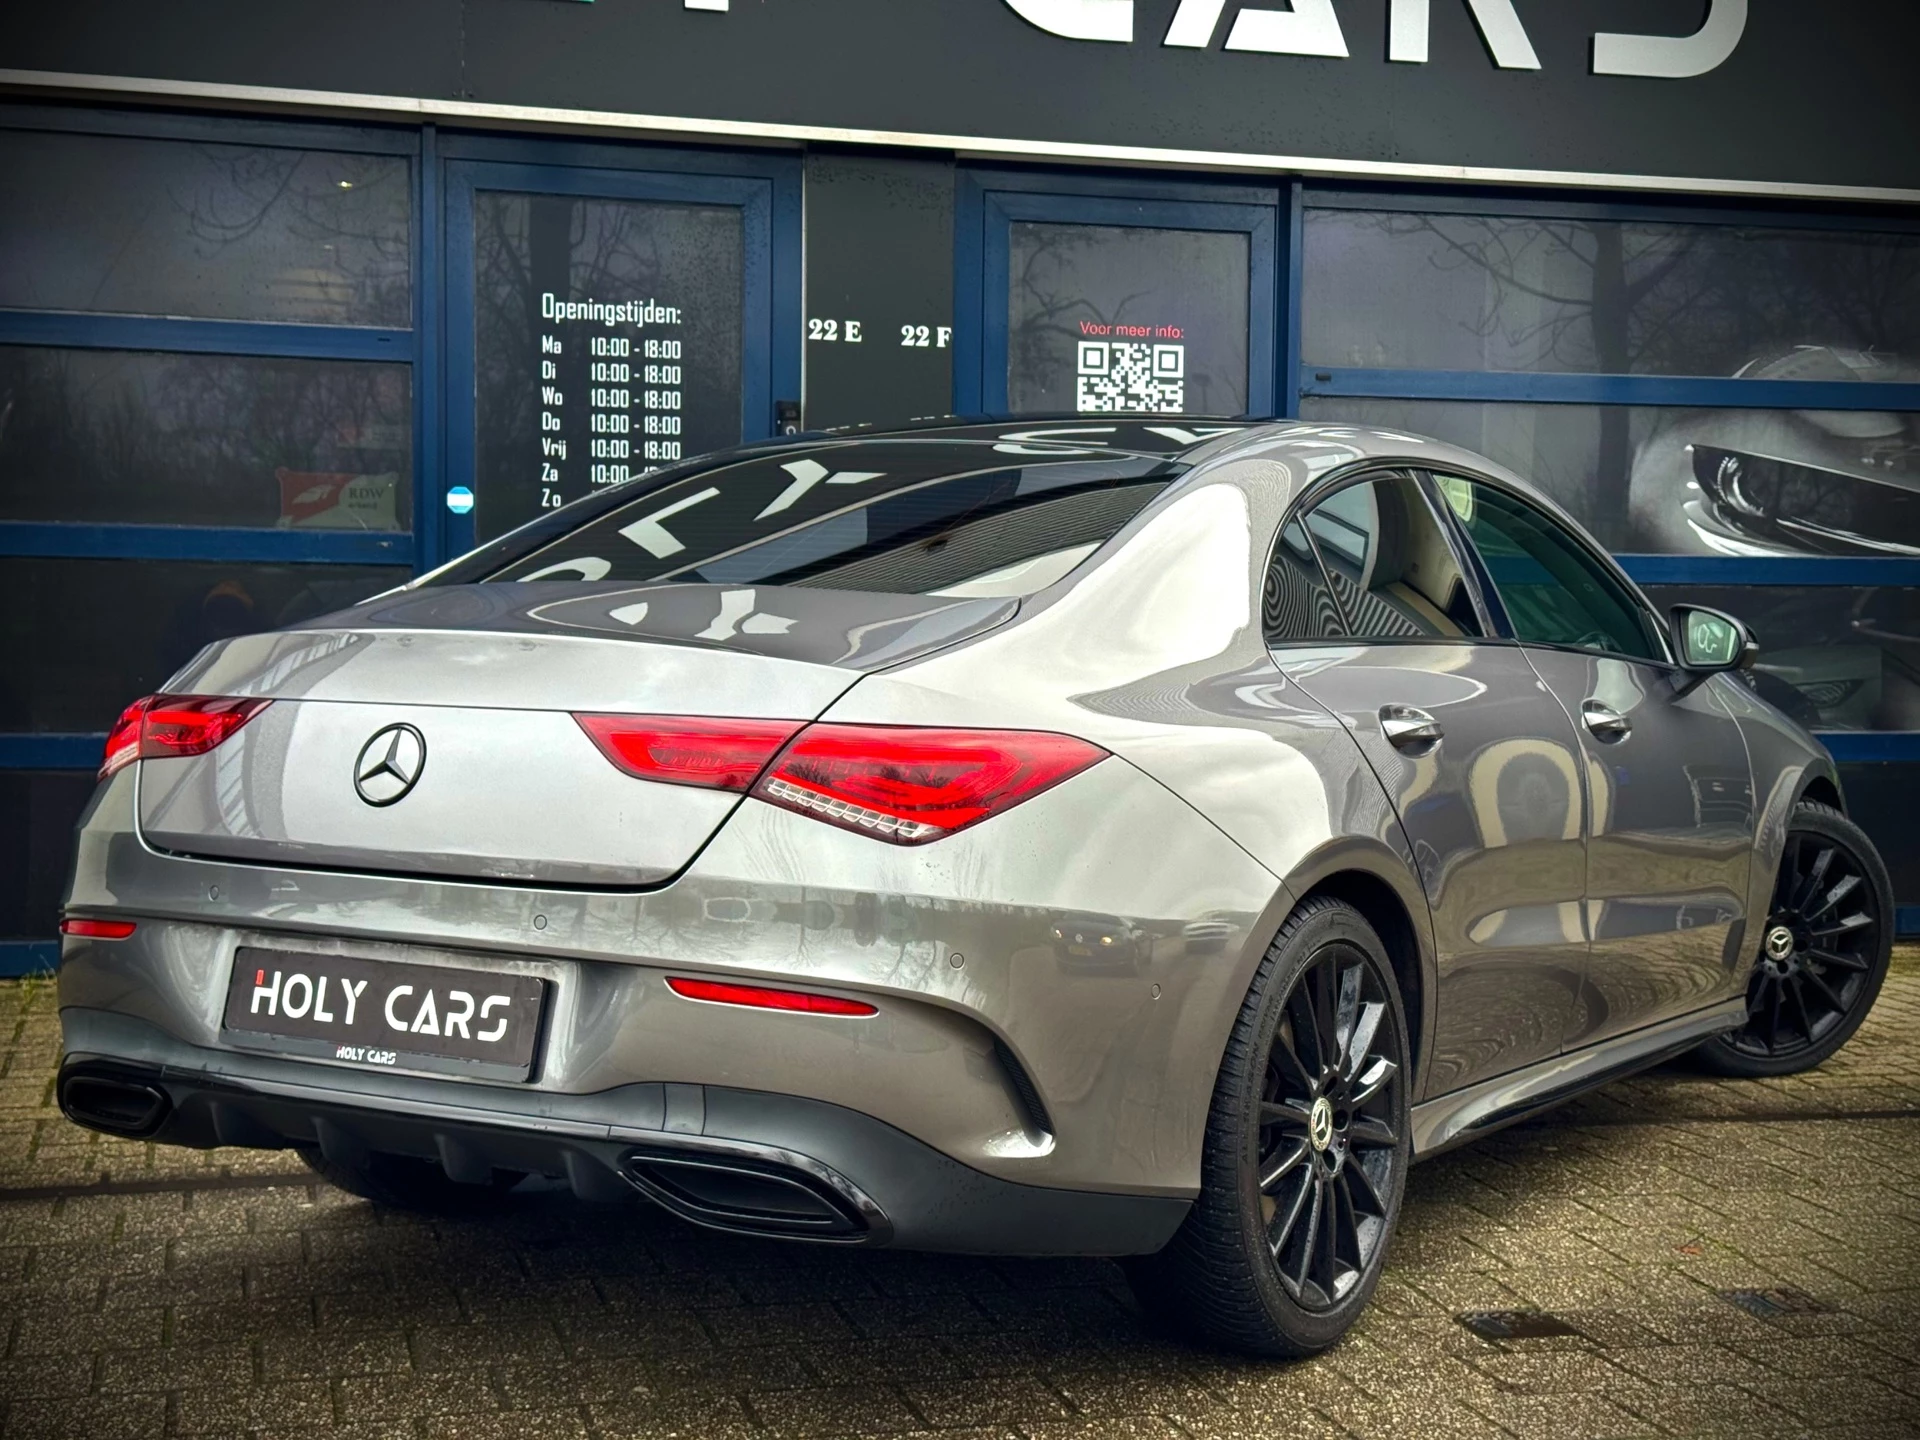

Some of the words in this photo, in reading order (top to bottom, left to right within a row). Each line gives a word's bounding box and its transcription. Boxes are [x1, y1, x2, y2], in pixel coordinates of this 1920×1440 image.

[543, 293, 681, 327] Openingstijden:
[809, 319, 837, 340] 22
[845, 321, 861, 342] E
[901, 325, 929, 346] 22
[937, 327, 951, 347] F
[1081, 321, 1112, 335] Voor
[1117, 326, 1151, 337] meer
[1156, 325, 1185, 338] info:
[543, 335, 561, 354] Ma
[592, 338, 629, 356] 10:00
[645, 340, 681, 359] 18:00
[543, 361, 555, 379] Di
[592, 363, 629, 382] 10:00
[645, 366, 681, 384] 18:00
[542, 387, 562, 405] Wo
[592, 389, 629, 407] 10:00
[645, 391, 680, 409] 18:00
[543, 412, 560, 430] Do
[592, 414, 629, 433] 10:00
[645, 416, 680, 434] 18:00
[543, 438, 566, 460] Vrij
[592, 440, 628, 458] 10:00
[645, 441, 680, 459] 18:00
[542, 463, 558, 481] Za
[591, 465, 629, 484] 10:00
[348, 487, 384, 499] RDW
[251, 969, 367, 1024] HOLY
[385, 985, 510, 1041] CARS
[336, 1046, 365, 1060] HOLY
[366, 1050, 396, 1066] CARS
